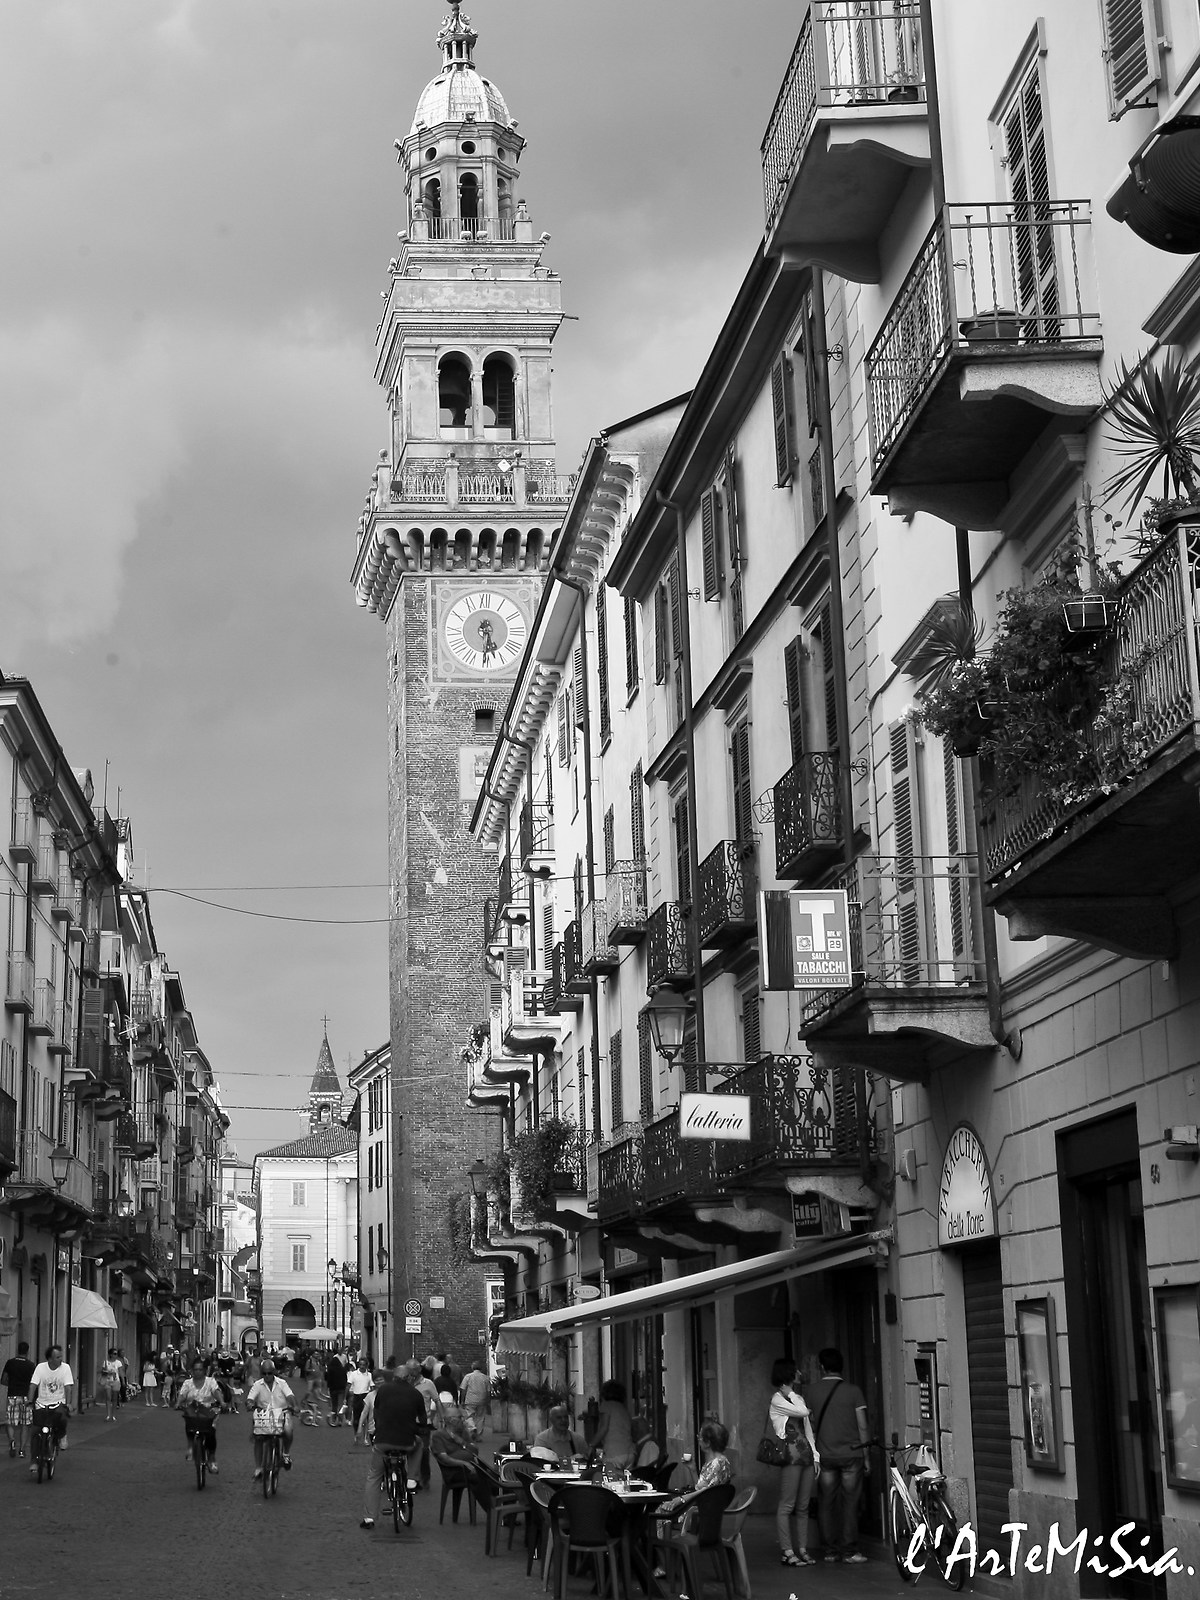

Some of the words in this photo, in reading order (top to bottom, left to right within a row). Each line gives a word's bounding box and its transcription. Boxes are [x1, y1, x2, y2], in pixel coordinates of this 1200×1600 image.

[798, 900, 836, 952] T
[829, 940, 842, 949] 29
[811, 952, 825, 960] SALI
[825, 952, 830, 960] E
[796, 960, 846, 974] TABACCHI
[939, 1130, 990, 1217] TABACCHERIA
[794, 1203, 821, 1224] illy
[947, 1211, 964, 1239] della
[966, 1210, 985, 1236] Torre
